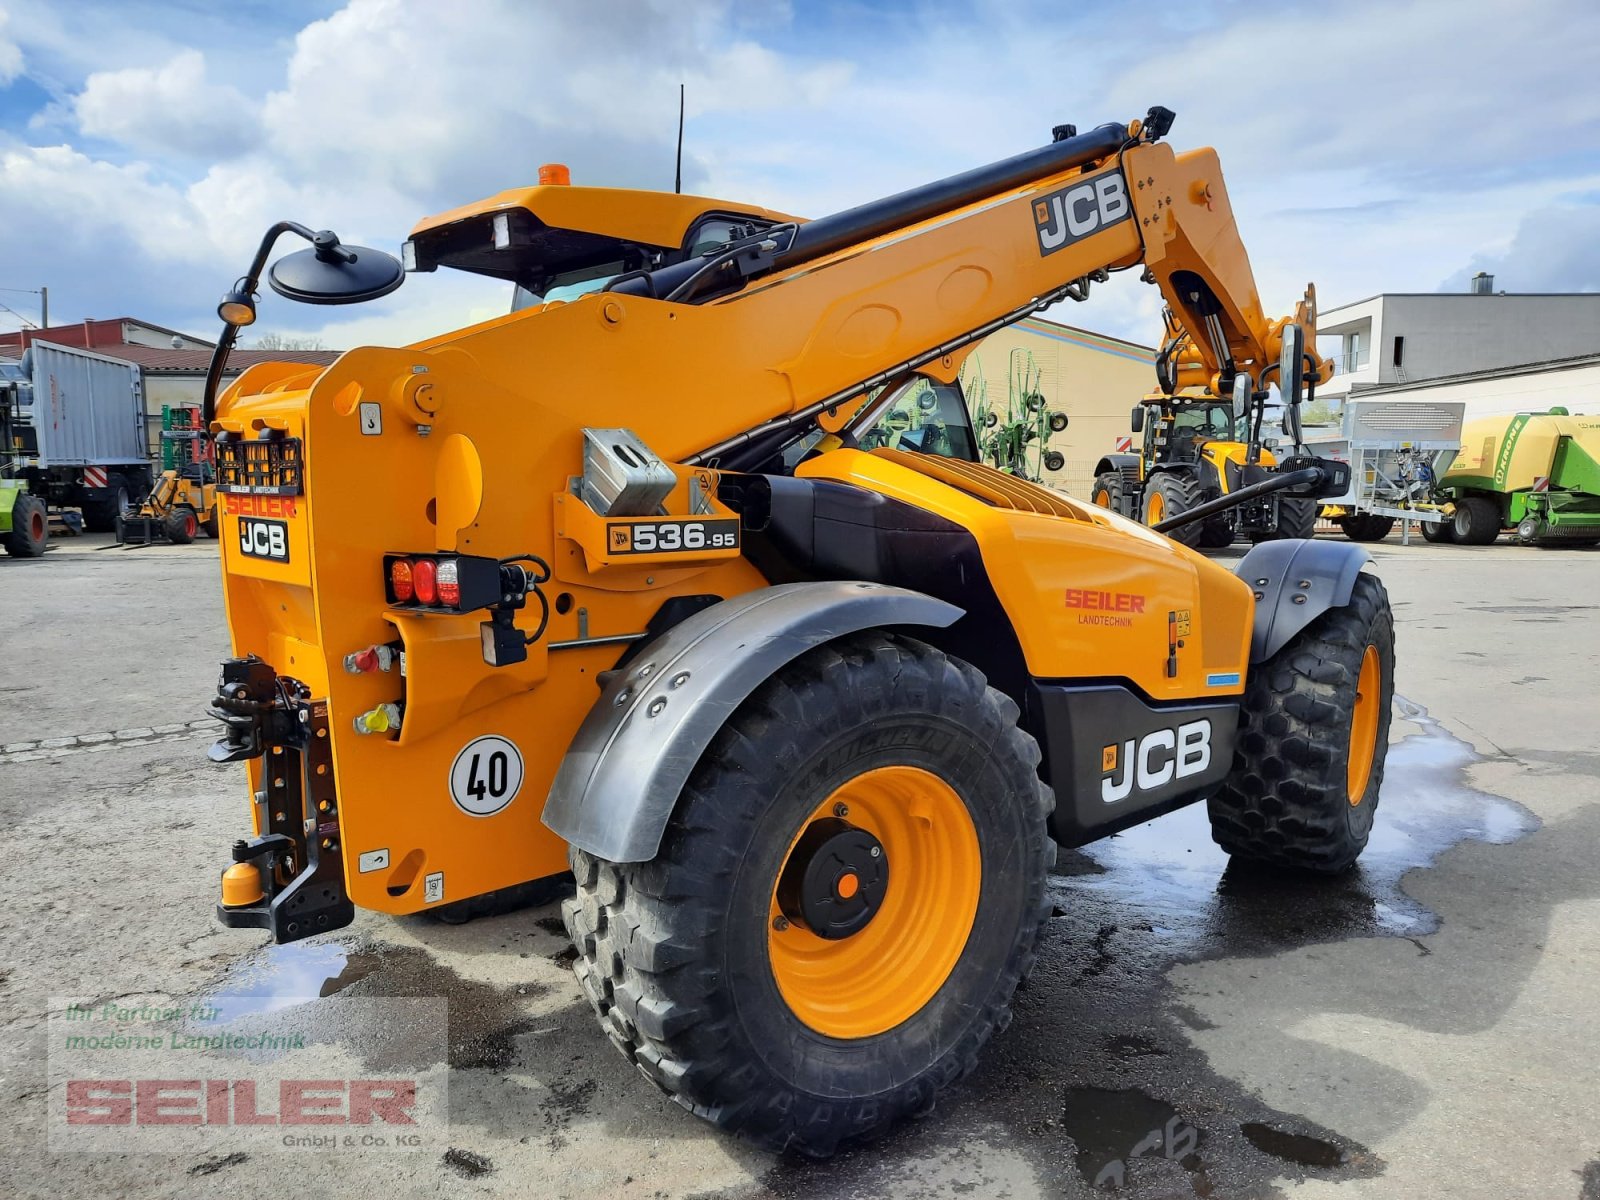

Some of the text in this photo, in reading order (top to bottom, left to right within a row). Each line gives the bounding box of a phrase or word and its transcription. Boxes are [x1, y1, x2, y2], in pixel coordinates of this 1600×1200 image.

[1040, 173, 1128, 249] JCB
[1499, 419, 1522, 469] KRONE
[226, 494, 296, 518] SEILER
[241, 522, 286, 558] JCB
[1065, 588, 1146, 613] SEILER
[1078, 614, 1133, 628] LANDTECHNIK
[467, 751, 508, 801] 40
[1101, 719, 1212, 803] JCB
